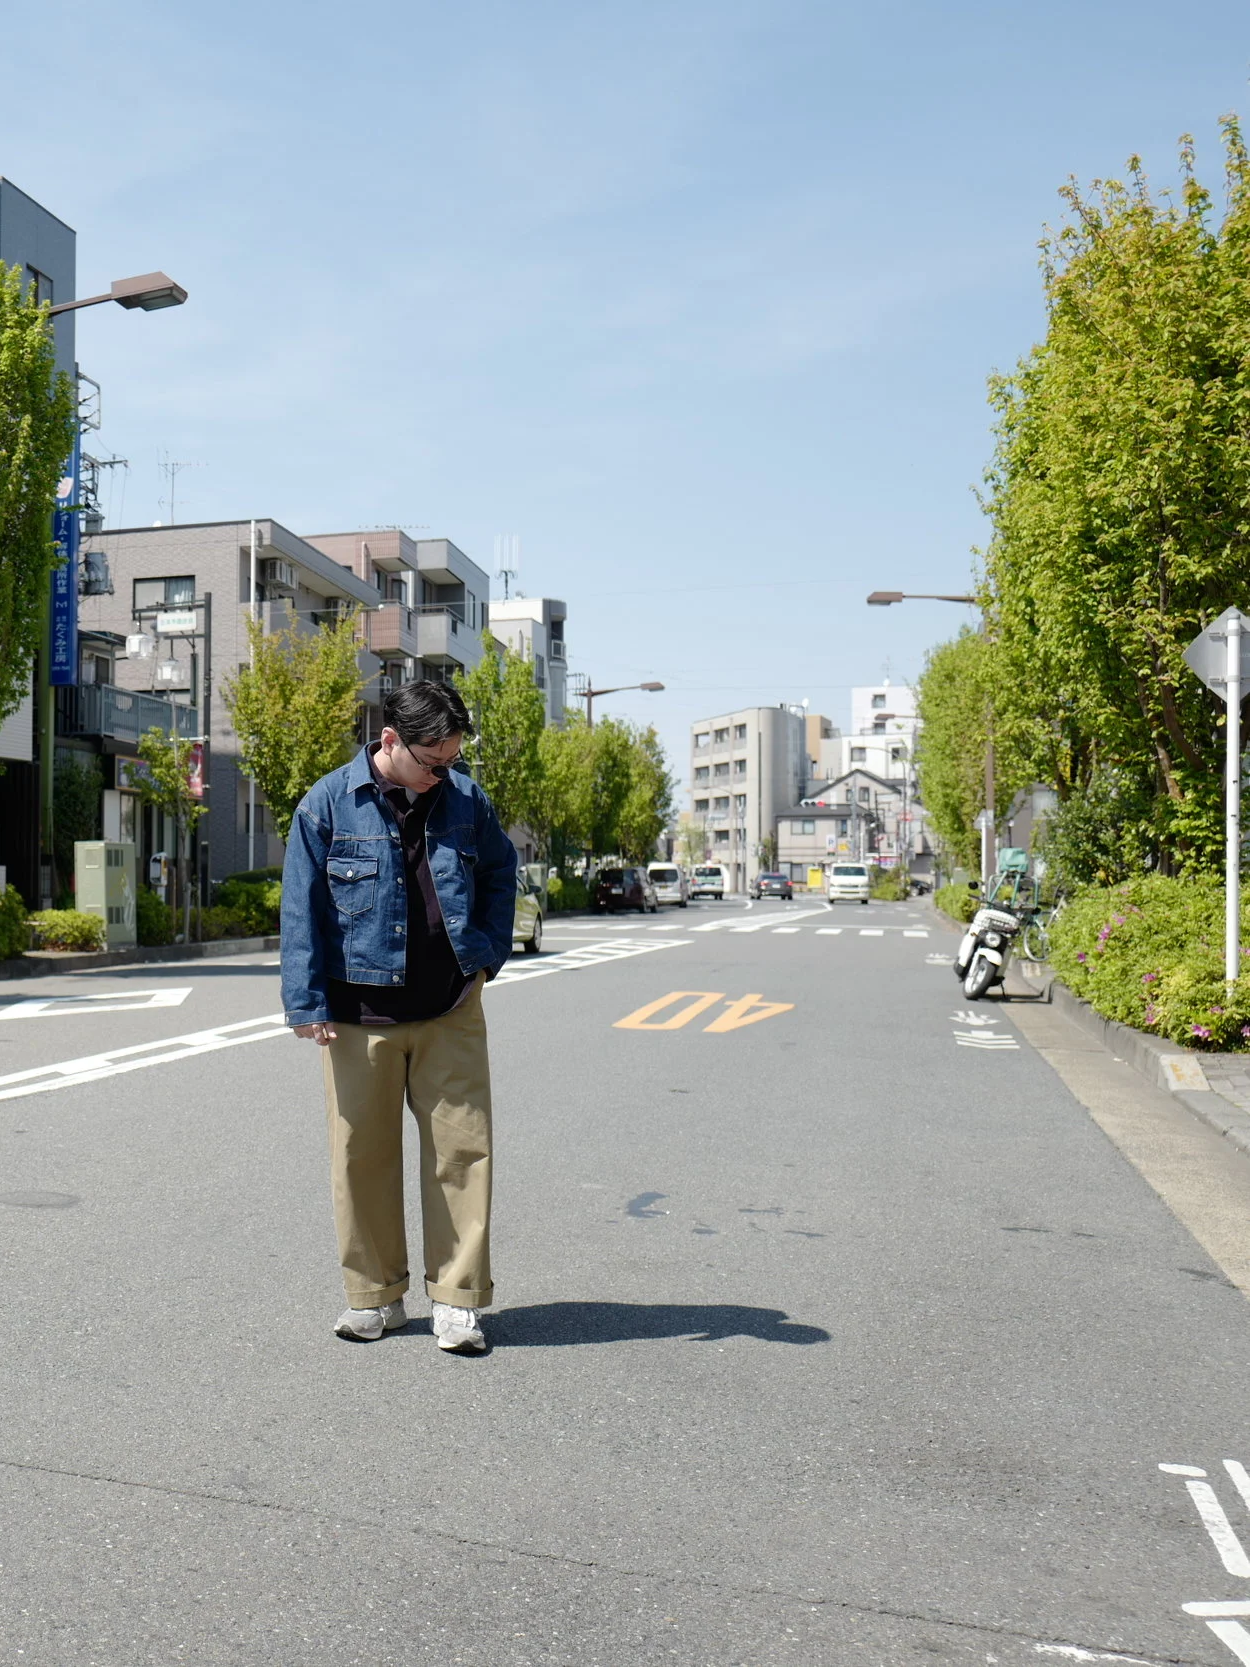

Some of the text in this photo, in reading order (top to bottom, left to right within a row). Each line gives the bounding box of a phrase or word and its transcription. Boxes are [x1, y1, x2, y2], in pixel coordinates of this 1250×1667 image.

[54, 623, 67, 663] たくみ工房
[611, 991, 796, 1033] 40
